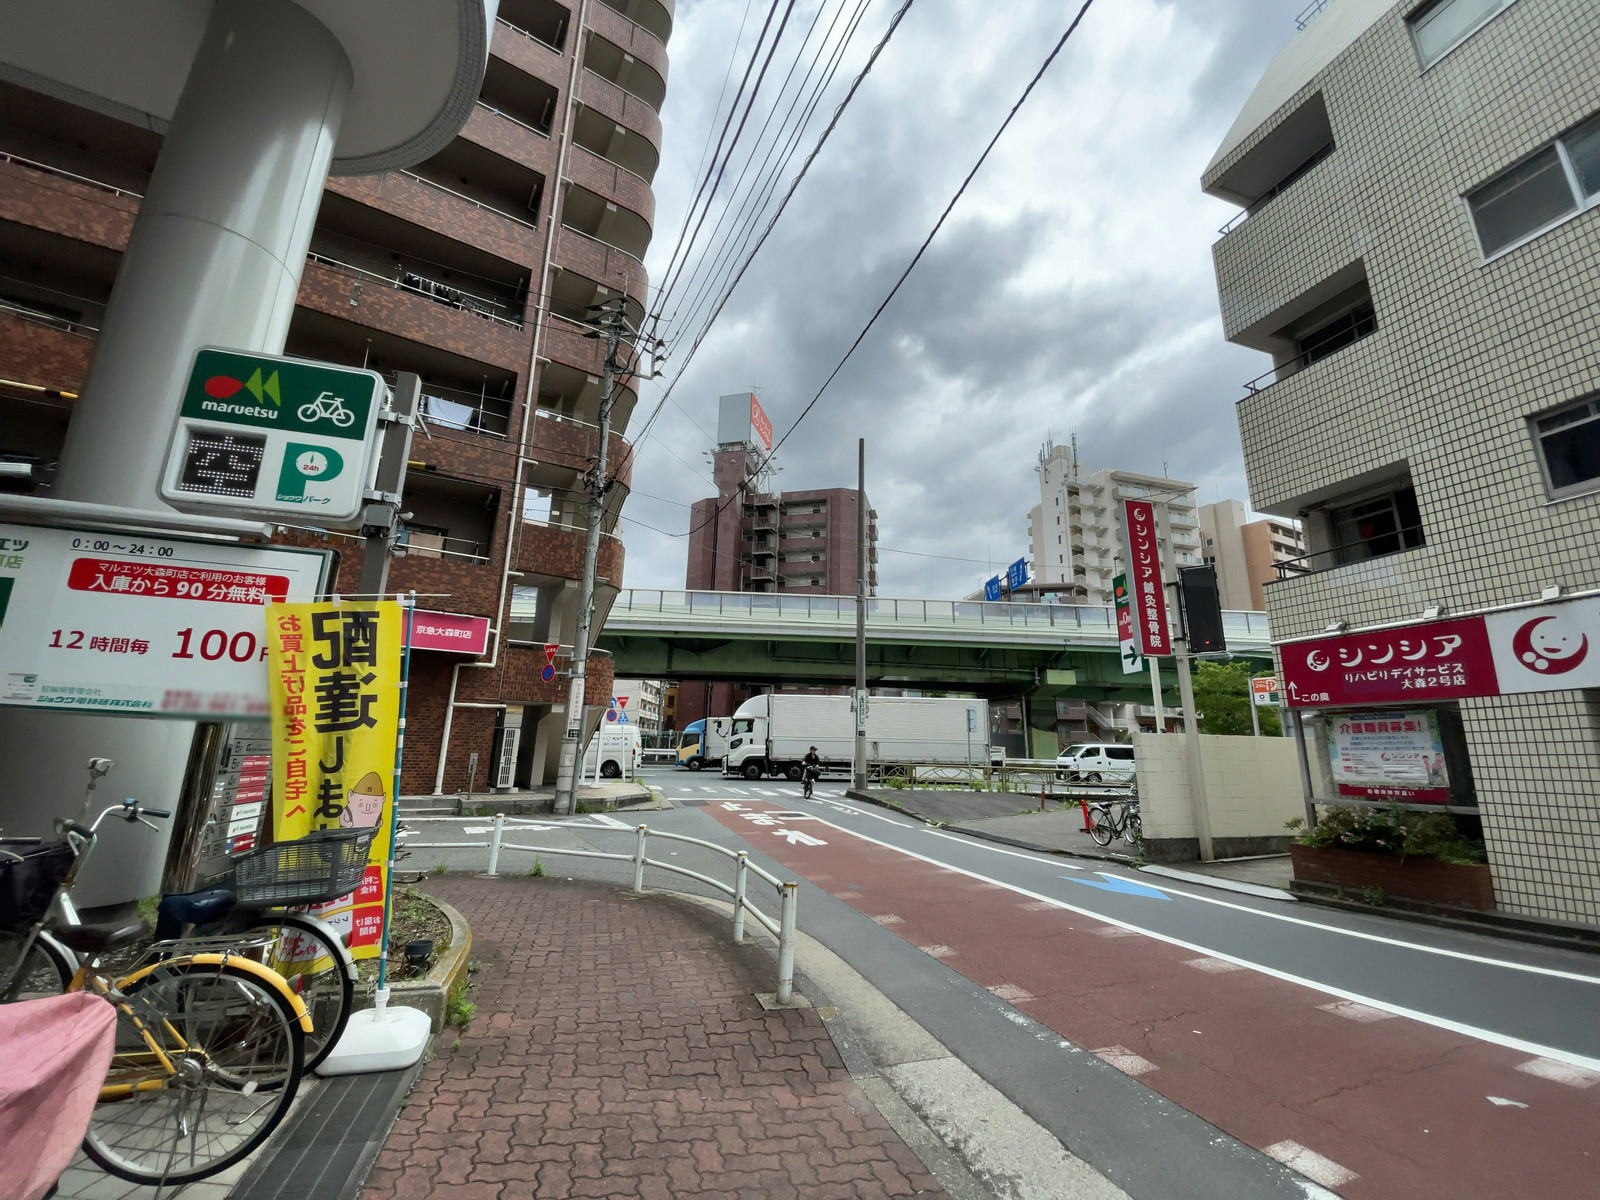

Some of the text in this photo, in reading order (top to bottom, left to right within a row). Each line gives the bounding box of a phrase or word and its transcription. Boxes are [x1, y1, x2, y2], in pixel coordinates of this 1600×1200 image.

[201, 400, 279, 419] maruetsu
[303, 464, 319, 472] 24h
[98, 562, 267, 586] マルエツ大森町店ご利用のお客様
[88, 574, 267, 603] 入庫から 90 分無料
[1136, 524, 1162, 648] シンシア 鍼灸整骨院
[48, 629, 151, 655] 12 時間毎
[415, 624, 472, 640] 京急大森町店
[1338, 634, 1462, 668] シンシア
[1344, 662, 1465, 684] リハビリデイサービス
[1401, 674, 1466, 691] 大森2号店
[1301, 692, 1330, 702] この奥
